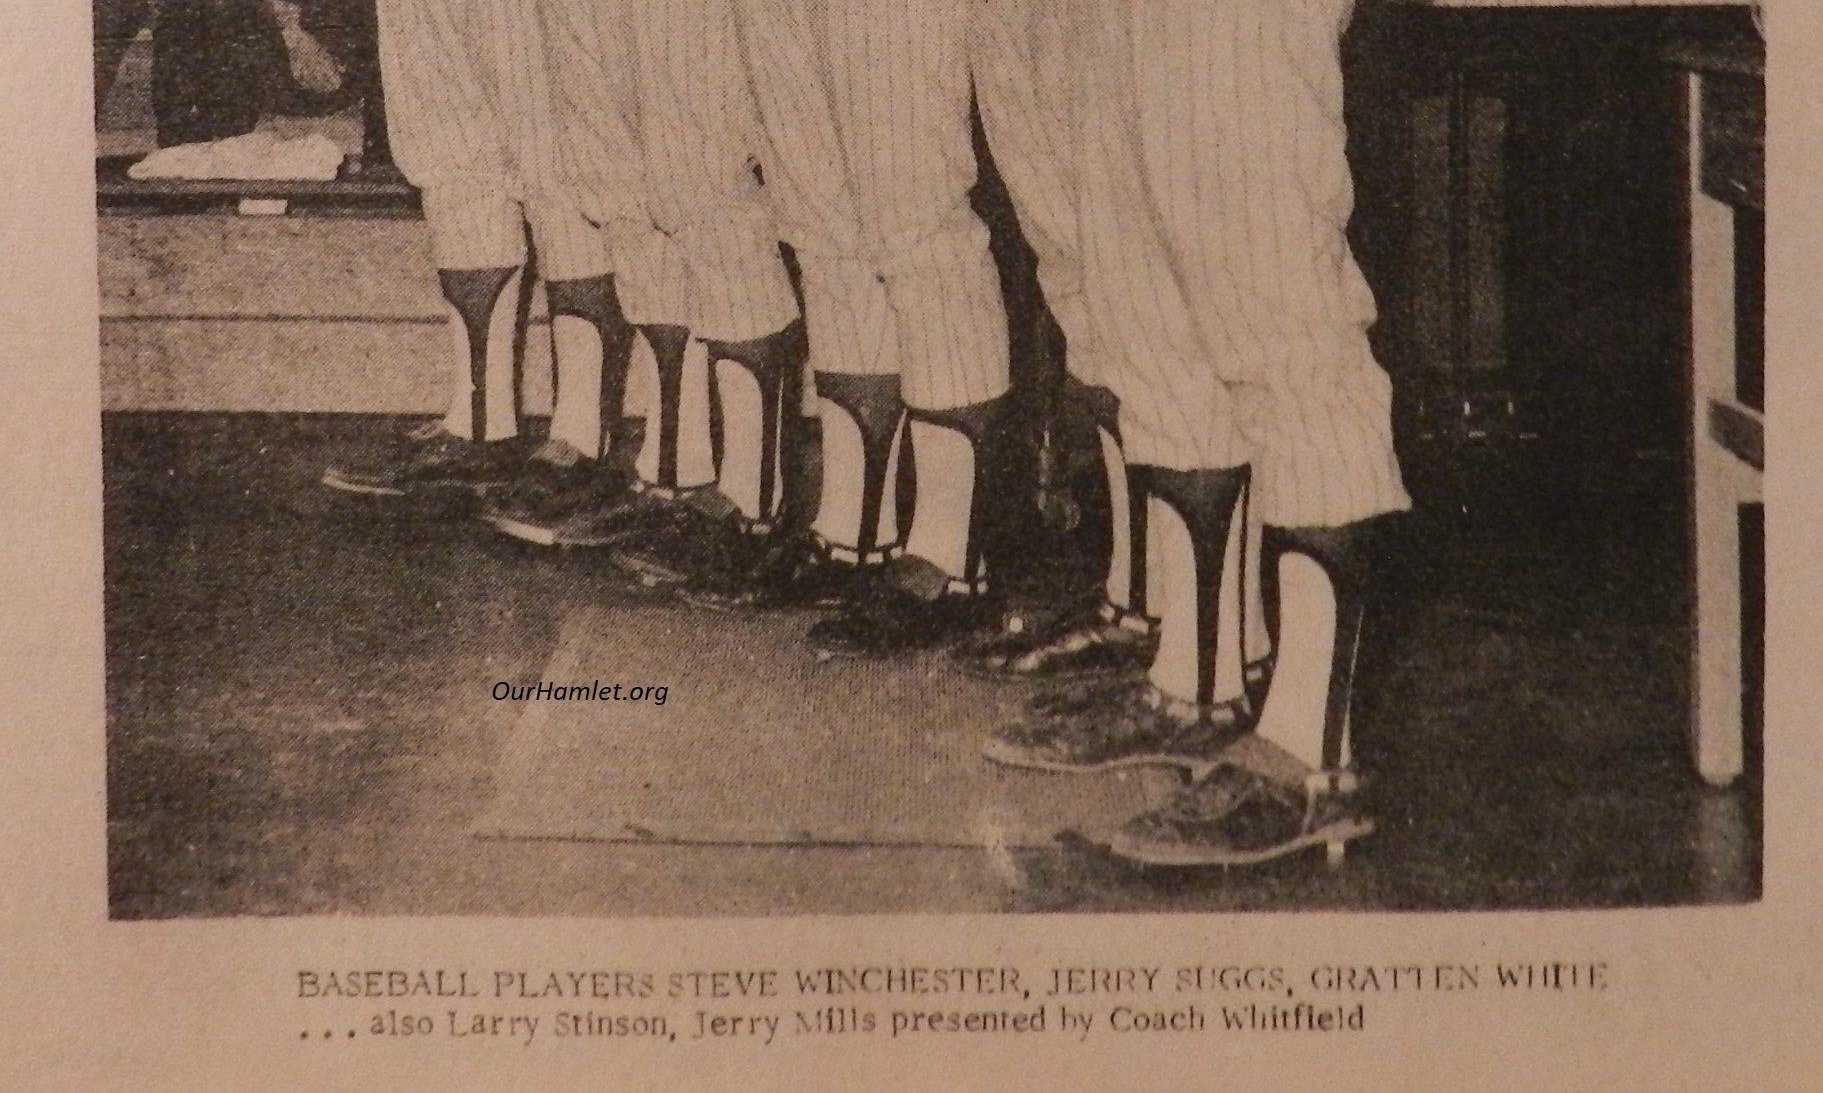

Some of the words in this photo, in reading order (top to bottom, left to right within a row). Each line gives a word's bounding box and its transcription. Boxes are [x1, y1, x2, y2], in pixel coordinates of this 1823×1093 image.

[297, 969, 480, 998] BASEBALL
[494, 969, 655, 999] PLAYERS
[668, 969, 778, 998] STEVE
[795, 966, 1030, 1000] WINCHESTER,
[1046, 966, 1161, 996] JERRY
[1176, 965, 1294, 998] SUGGS,
[1310, 964, 1479, 992] GRATTEN
[369, 1009, 434, 1037] also
[447, 1010, 540, 1046] Larry
[554, 1010, 676, 1042] Stinson,
[692, 1010, 779, 1045] Jerry
[795, 1006, 876, 1034] Mills
[891, 1004, 1046, 1039] presented
[1060, 1005, 1094, 1042] by
[1109, 1005, 1205, 1032] Coach
[1222, 1002, 1364, 1032] Whitfield
